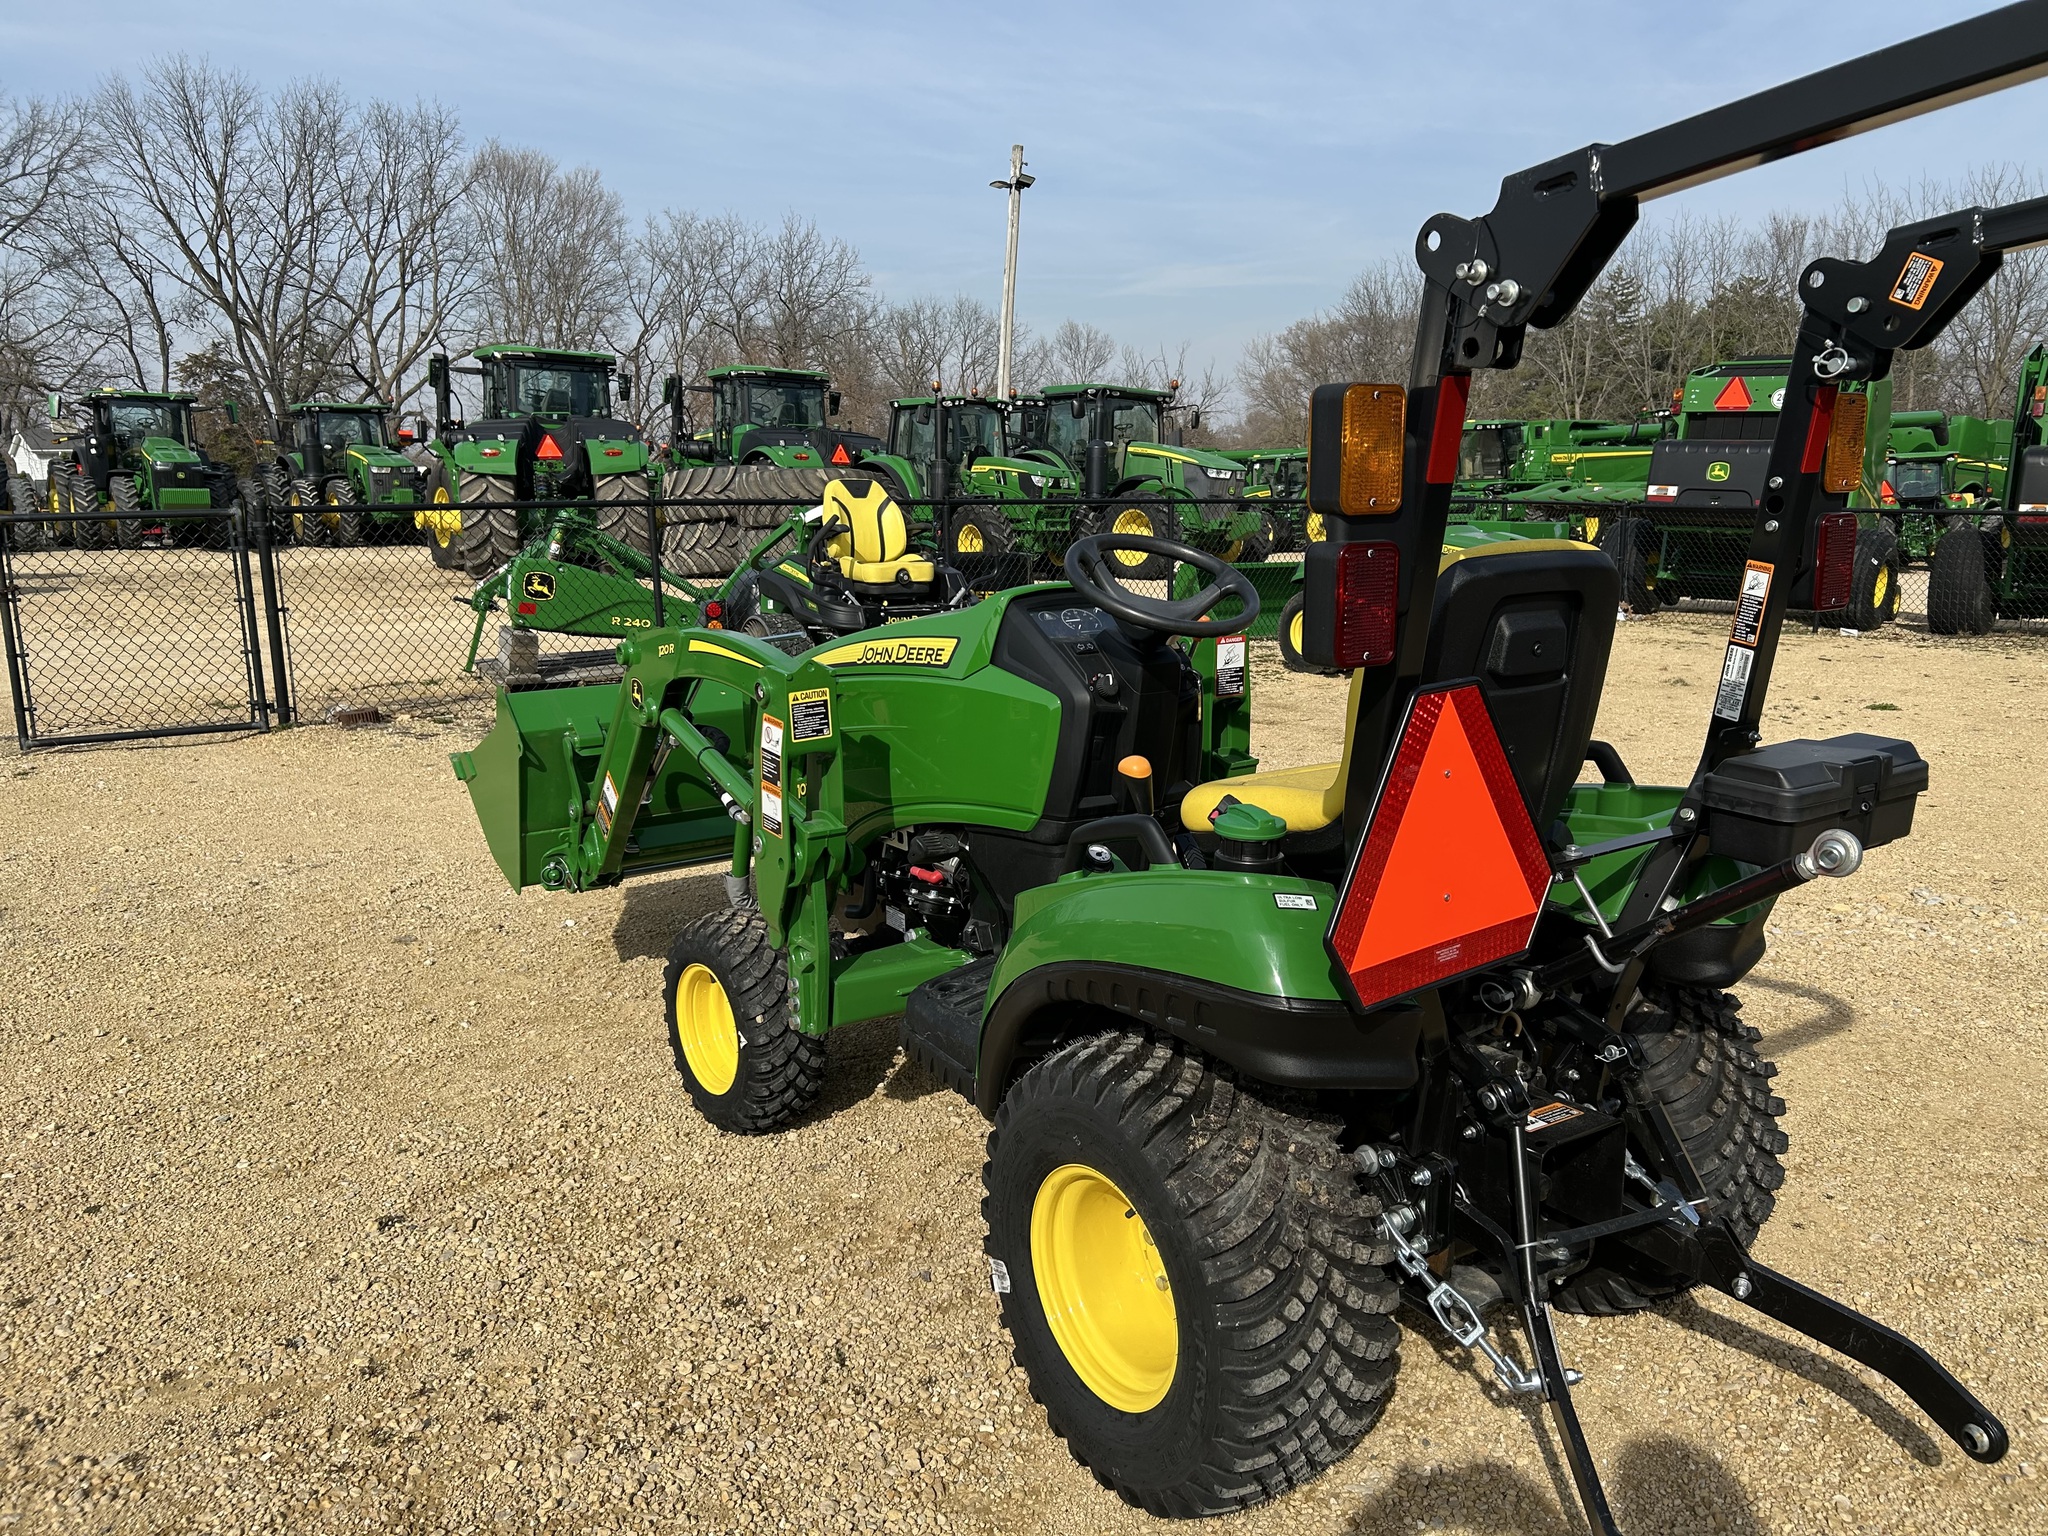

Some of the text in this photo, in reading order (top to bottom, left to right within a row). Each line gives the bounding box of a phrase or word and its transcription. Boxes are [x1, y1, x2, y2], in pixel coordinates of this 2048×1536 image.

[1914, 272, 1935, 305] WARNING
[1752, 564, 1772, 573] WARNING
[612, 616, 651, 628] R 240
[857, 643, 945, 662] JOHN DEERE
[800, 690, 828, 701] CAUTION
[797, 783, 807, 799] 10
